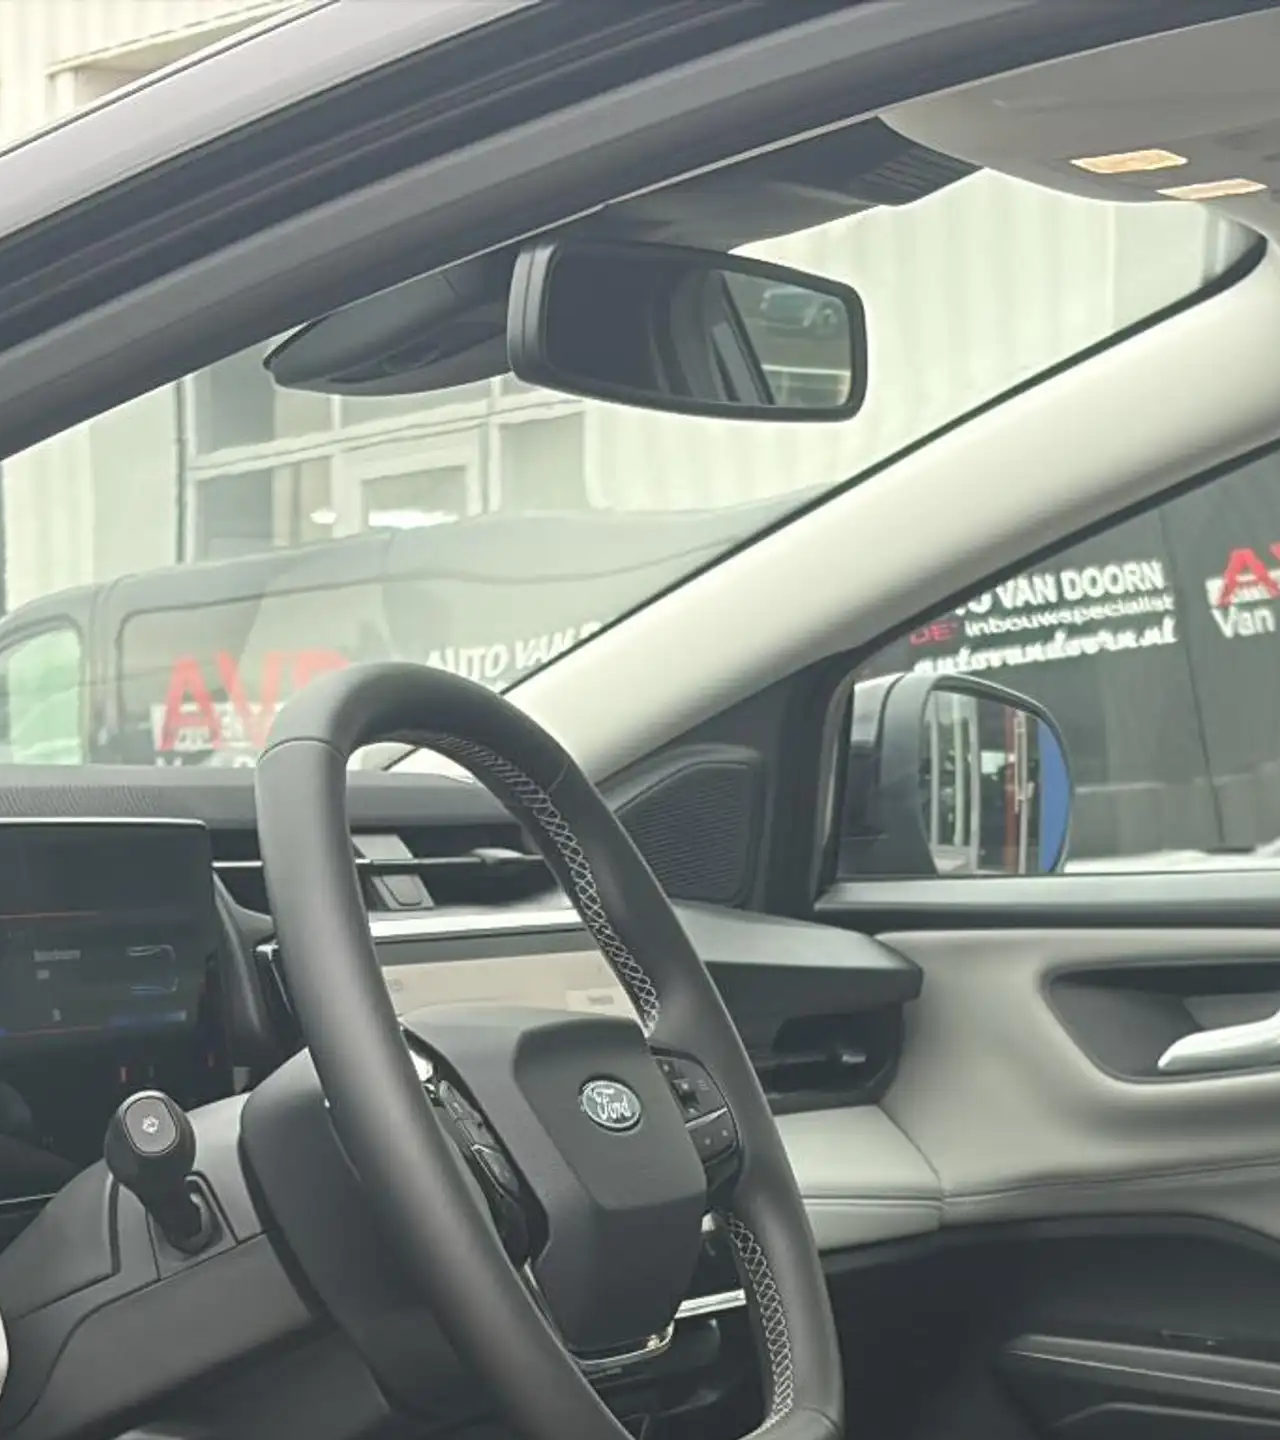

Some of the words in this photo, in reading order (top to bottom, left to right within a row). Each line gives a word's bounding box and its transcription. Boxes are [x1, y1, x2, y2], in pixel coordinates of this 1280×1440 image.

[995, 573, 1059, 609] VAN
[1060, 559, 1165, 601] DOORN
[1210, 604, 1276, 638] Van
[592, 1087, 632, 1120] Ford
